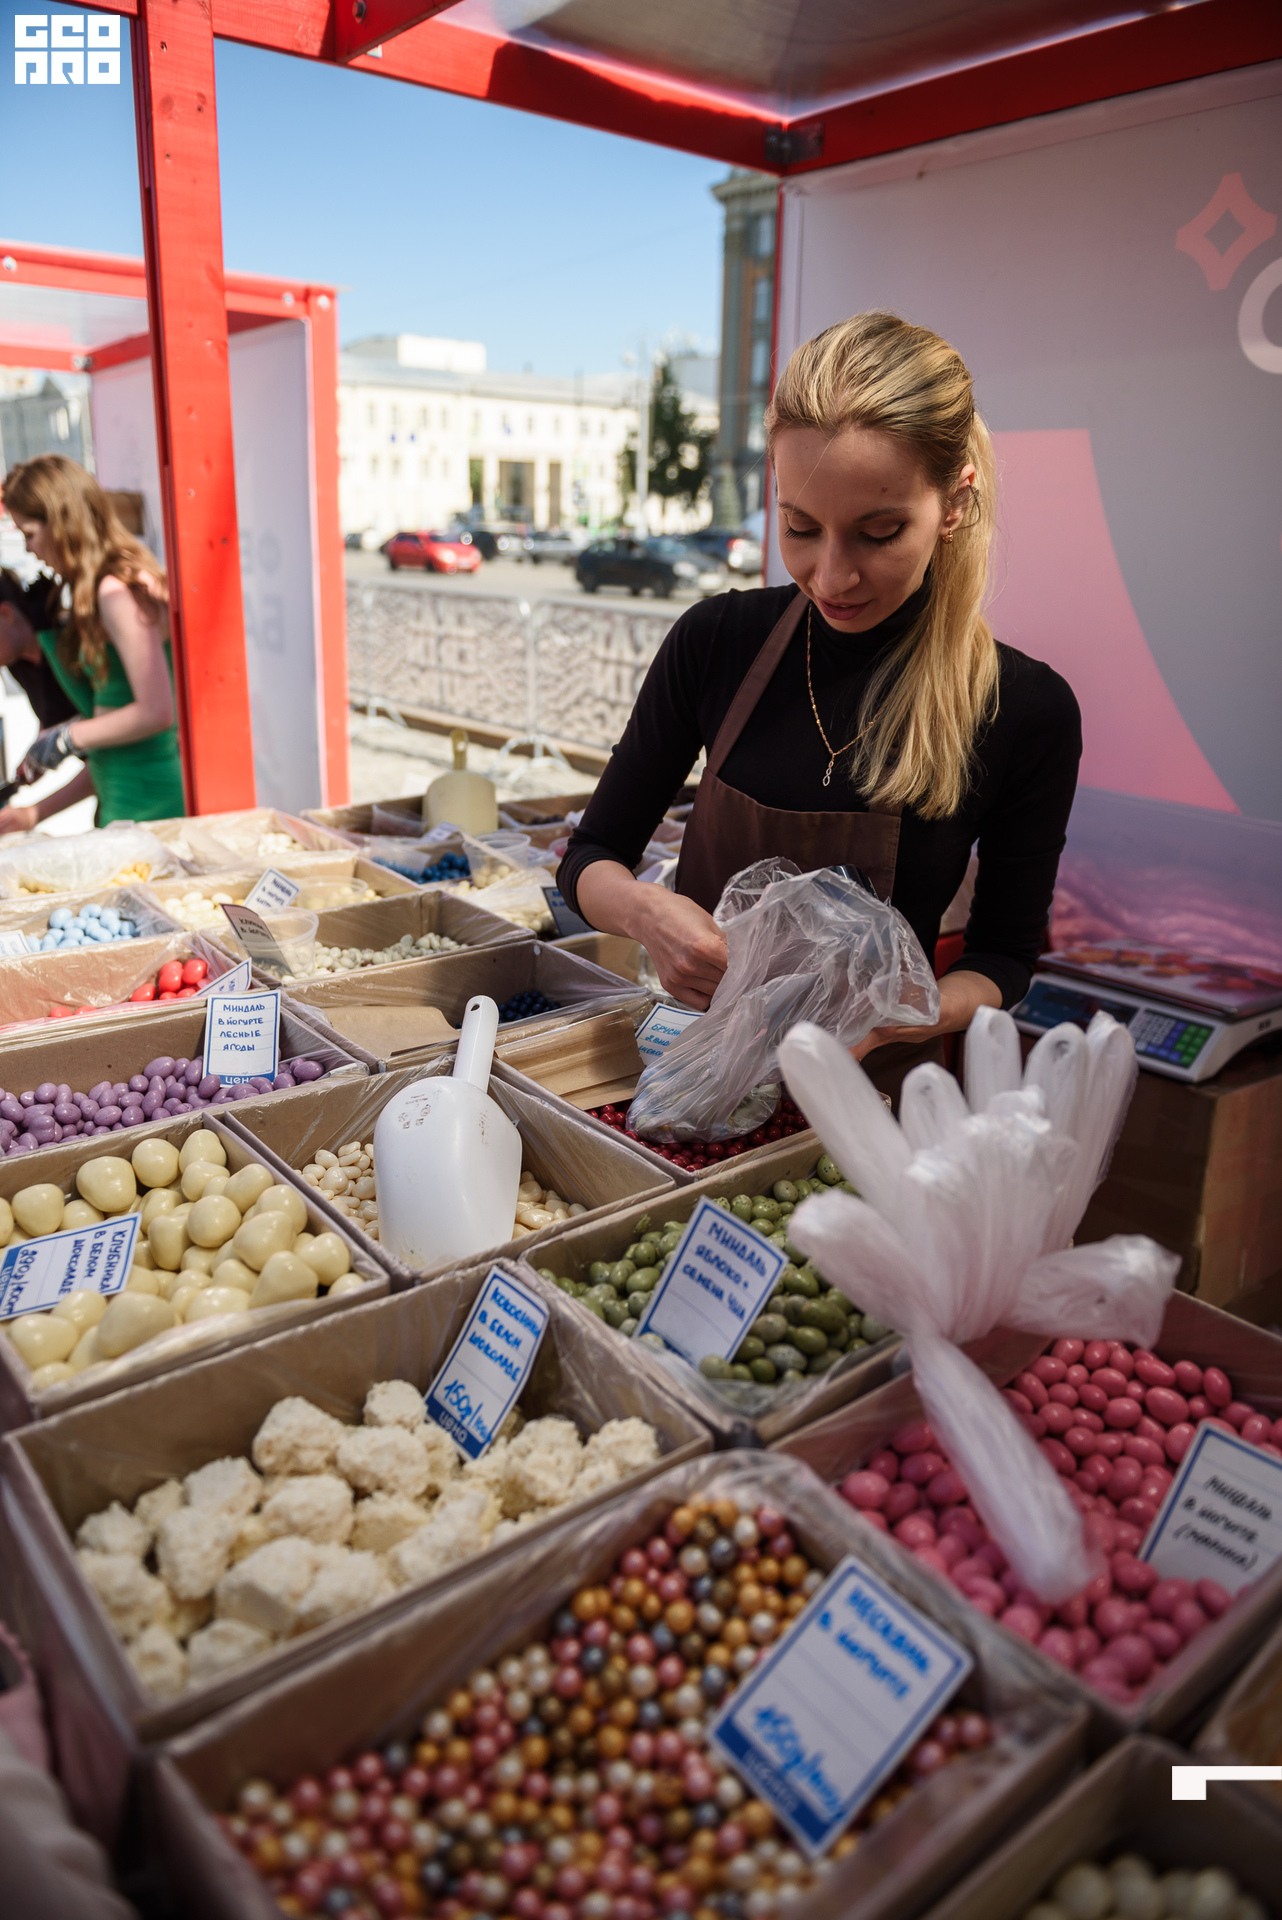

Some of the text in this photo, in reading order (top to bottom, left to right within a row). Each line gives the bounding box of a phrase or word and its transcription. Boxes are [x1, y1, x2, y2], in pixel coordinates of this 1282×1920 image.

[223, 1003, 266, 1013] МИНДАЛЬ
[226, 1016, 264, 1025] ЙОГУРТЕ
[219, 1029, 262, 1038] ЛЕСНЫЕ
[222, 1043, 255, 1052] ЯГОДЫ
[225, 1076, 252, 1085] цен
[58, 1239, 86, 1295] ШОКОЛАДЕ
[84, 1241, 104, 1278] БЕЛОМ
[98, 1229, 128, 1293] КЛУБНИКА
[695, 1244, 742, 1285] ЯБЛОКО
[708, 1221, 767, 1278] МИНДАЛЬ
[682, 1263, 724, 1302] СЕМЕНА
